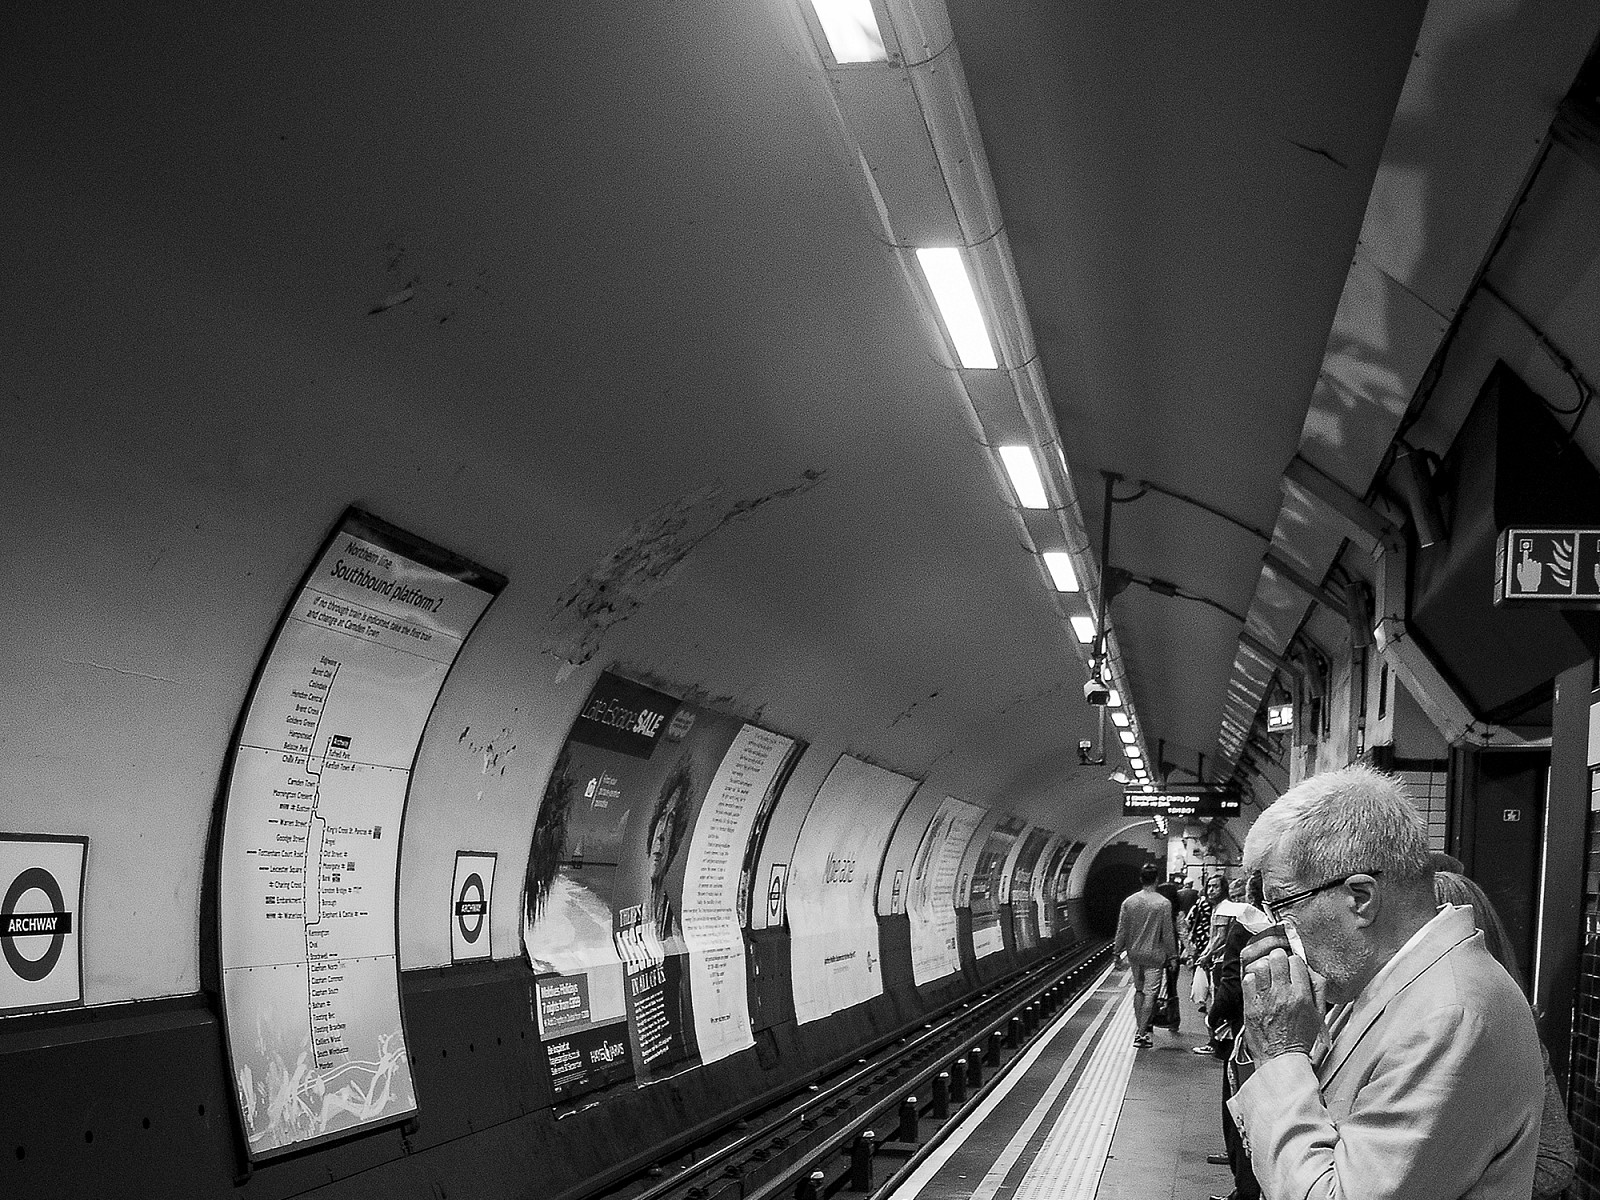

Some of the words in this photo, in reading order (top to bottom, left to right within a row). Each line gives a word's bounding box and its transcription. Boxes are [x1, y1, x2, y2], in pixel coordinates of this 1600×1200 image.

[345, 542, 380, 564] Northern
[377, 554, 393, 569] line
[330, 559, 395, 596] Southbound
[389, 582, 434, 612] platform
[433, 598, 444, 613] 2
[632, 708, 665, 738] SALE
[8, 917, 58, 932] ARCHWAY
